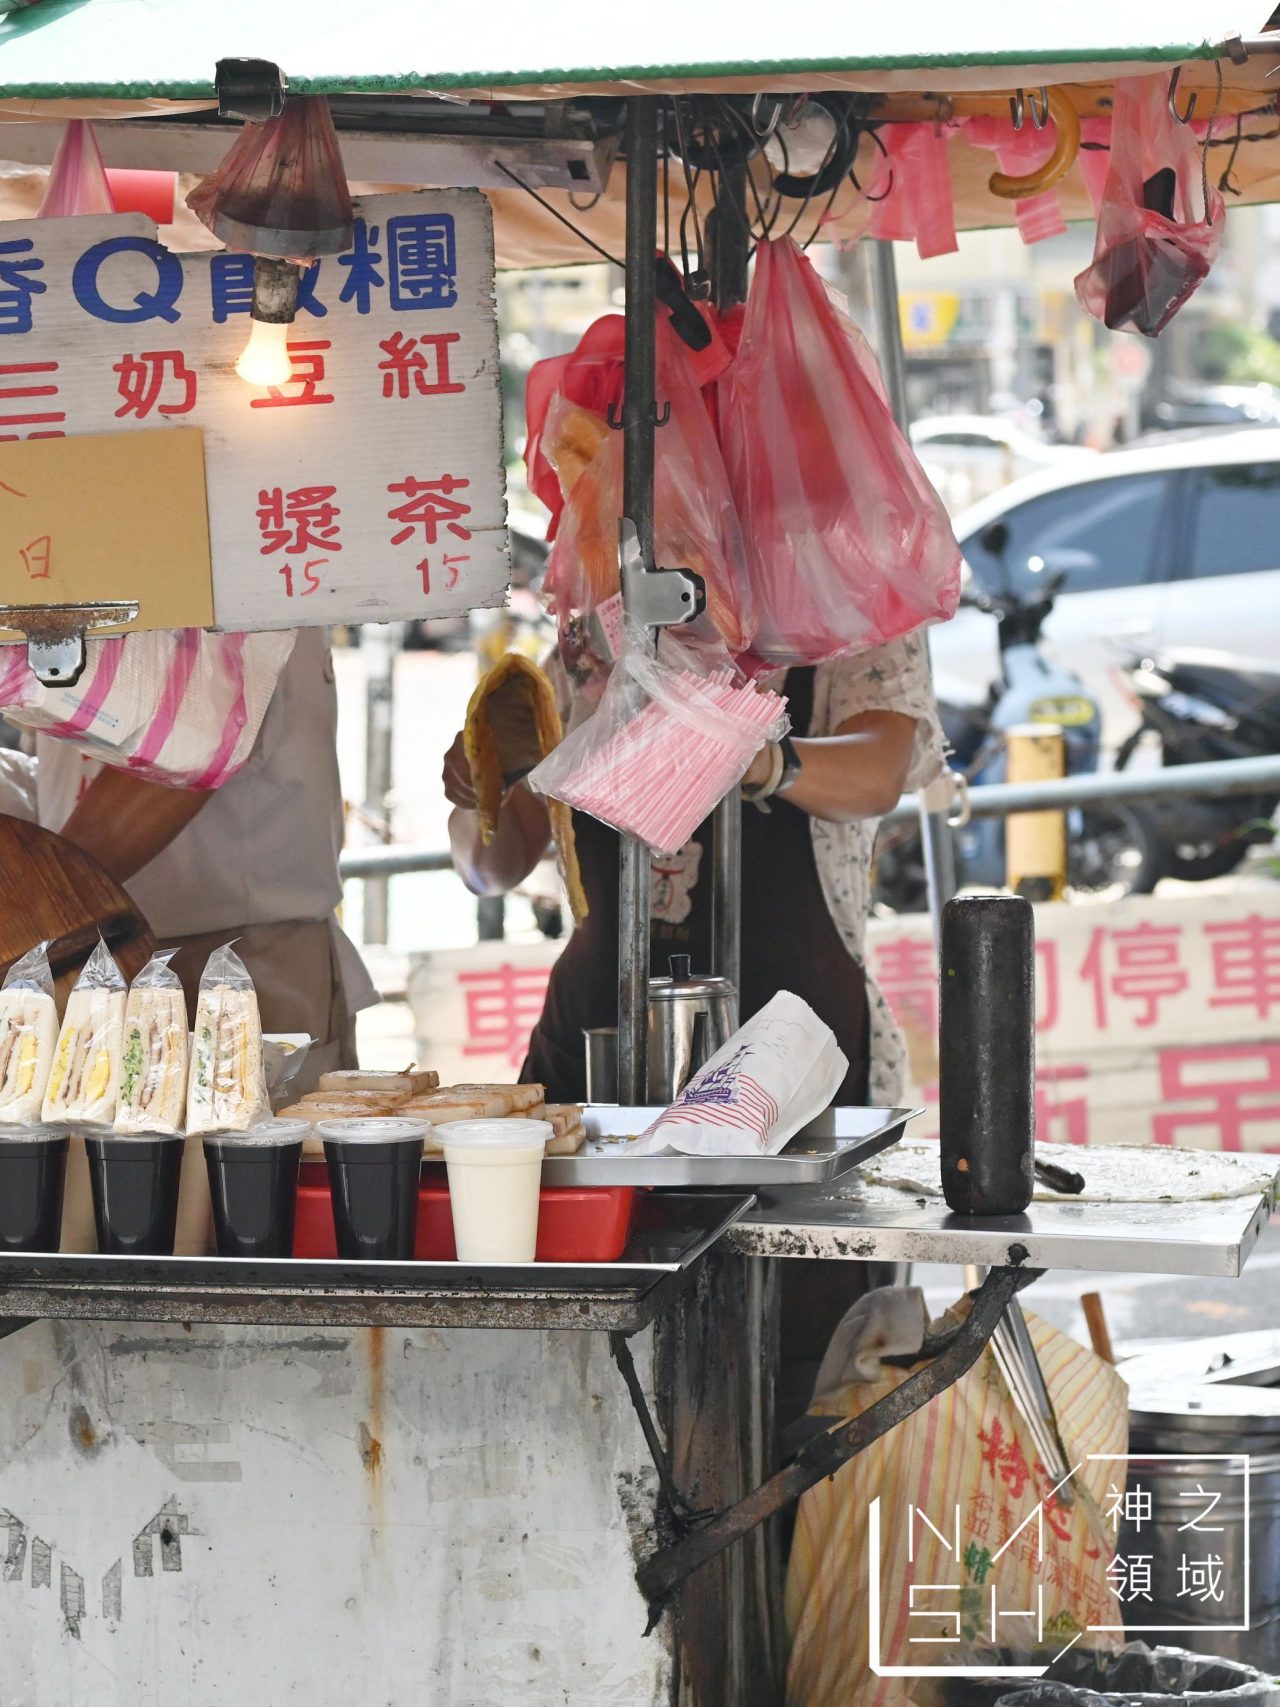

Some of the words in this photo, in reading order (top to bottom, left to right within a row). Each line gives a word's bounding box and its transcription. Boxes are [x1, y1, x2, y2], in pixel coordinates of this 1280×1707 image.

[113, 350, 198, 419] 奶
[377, 331, 472, 546] 紅茶
[278, 558, 330, 598] 15
[416, 555, 471, 595] 15
